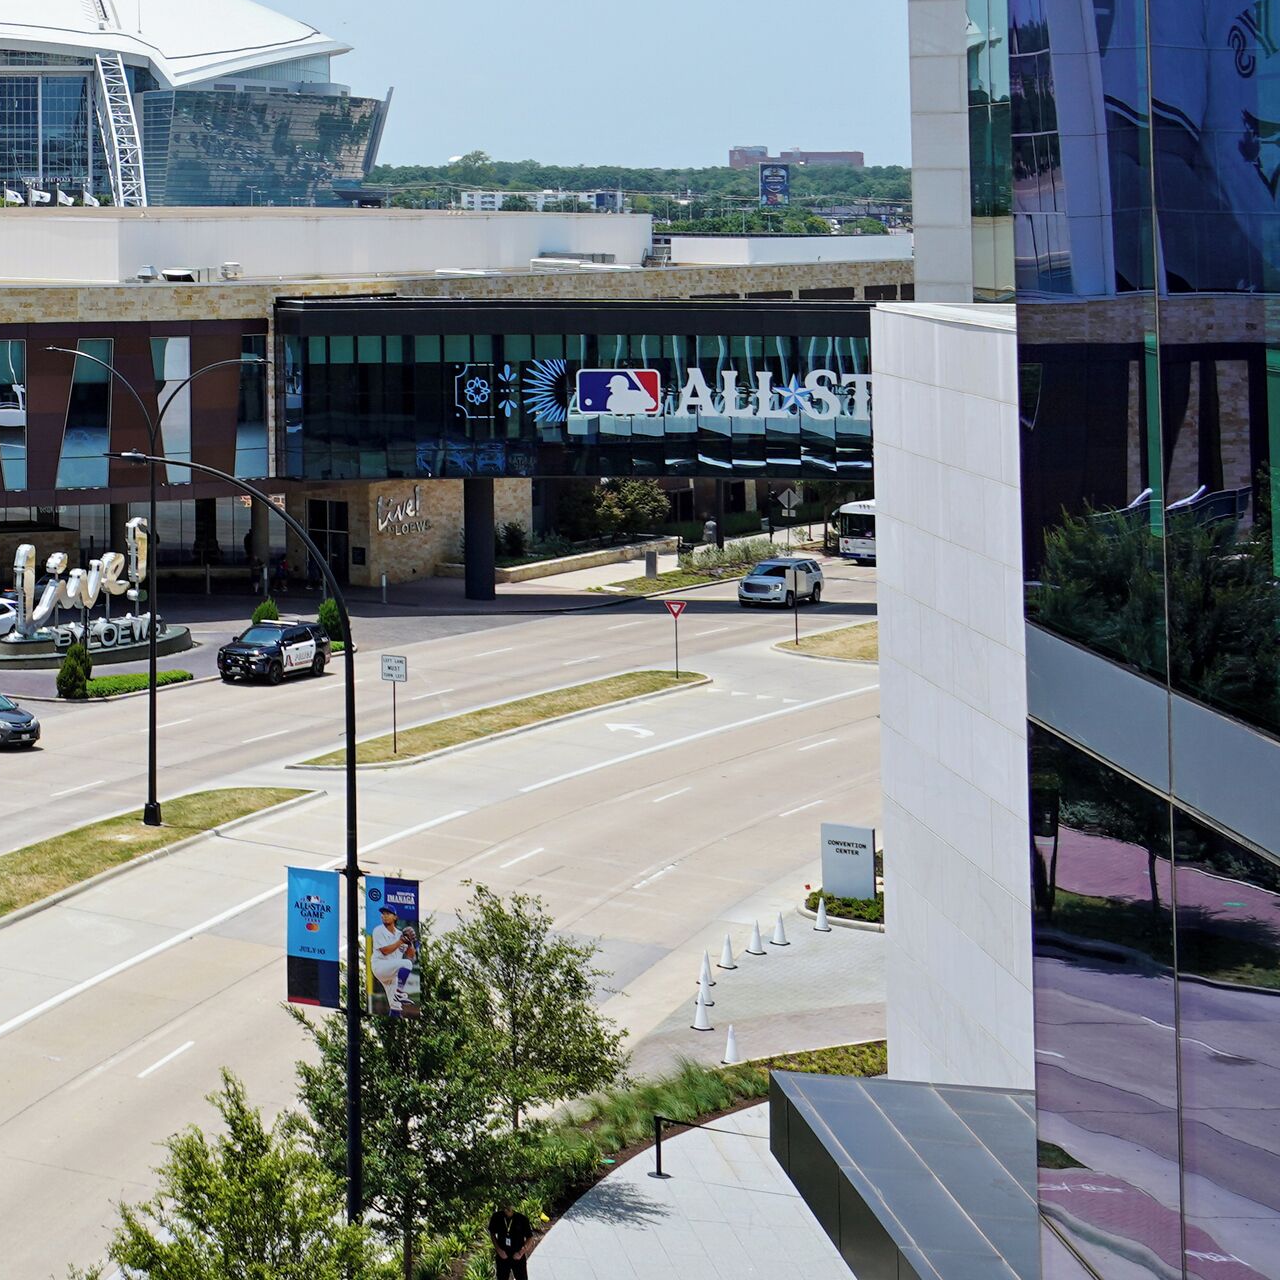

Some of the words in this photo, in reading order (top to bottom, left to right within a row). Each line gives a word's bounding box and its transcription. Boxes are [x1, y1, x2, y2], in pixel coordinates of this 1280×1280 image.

[13, 517, 148, 634] Live!
[827, 840, 867, 849] CONVENTION
[300, 910, 325, 919] GAME
[299, 946, 316, 954] JULY
